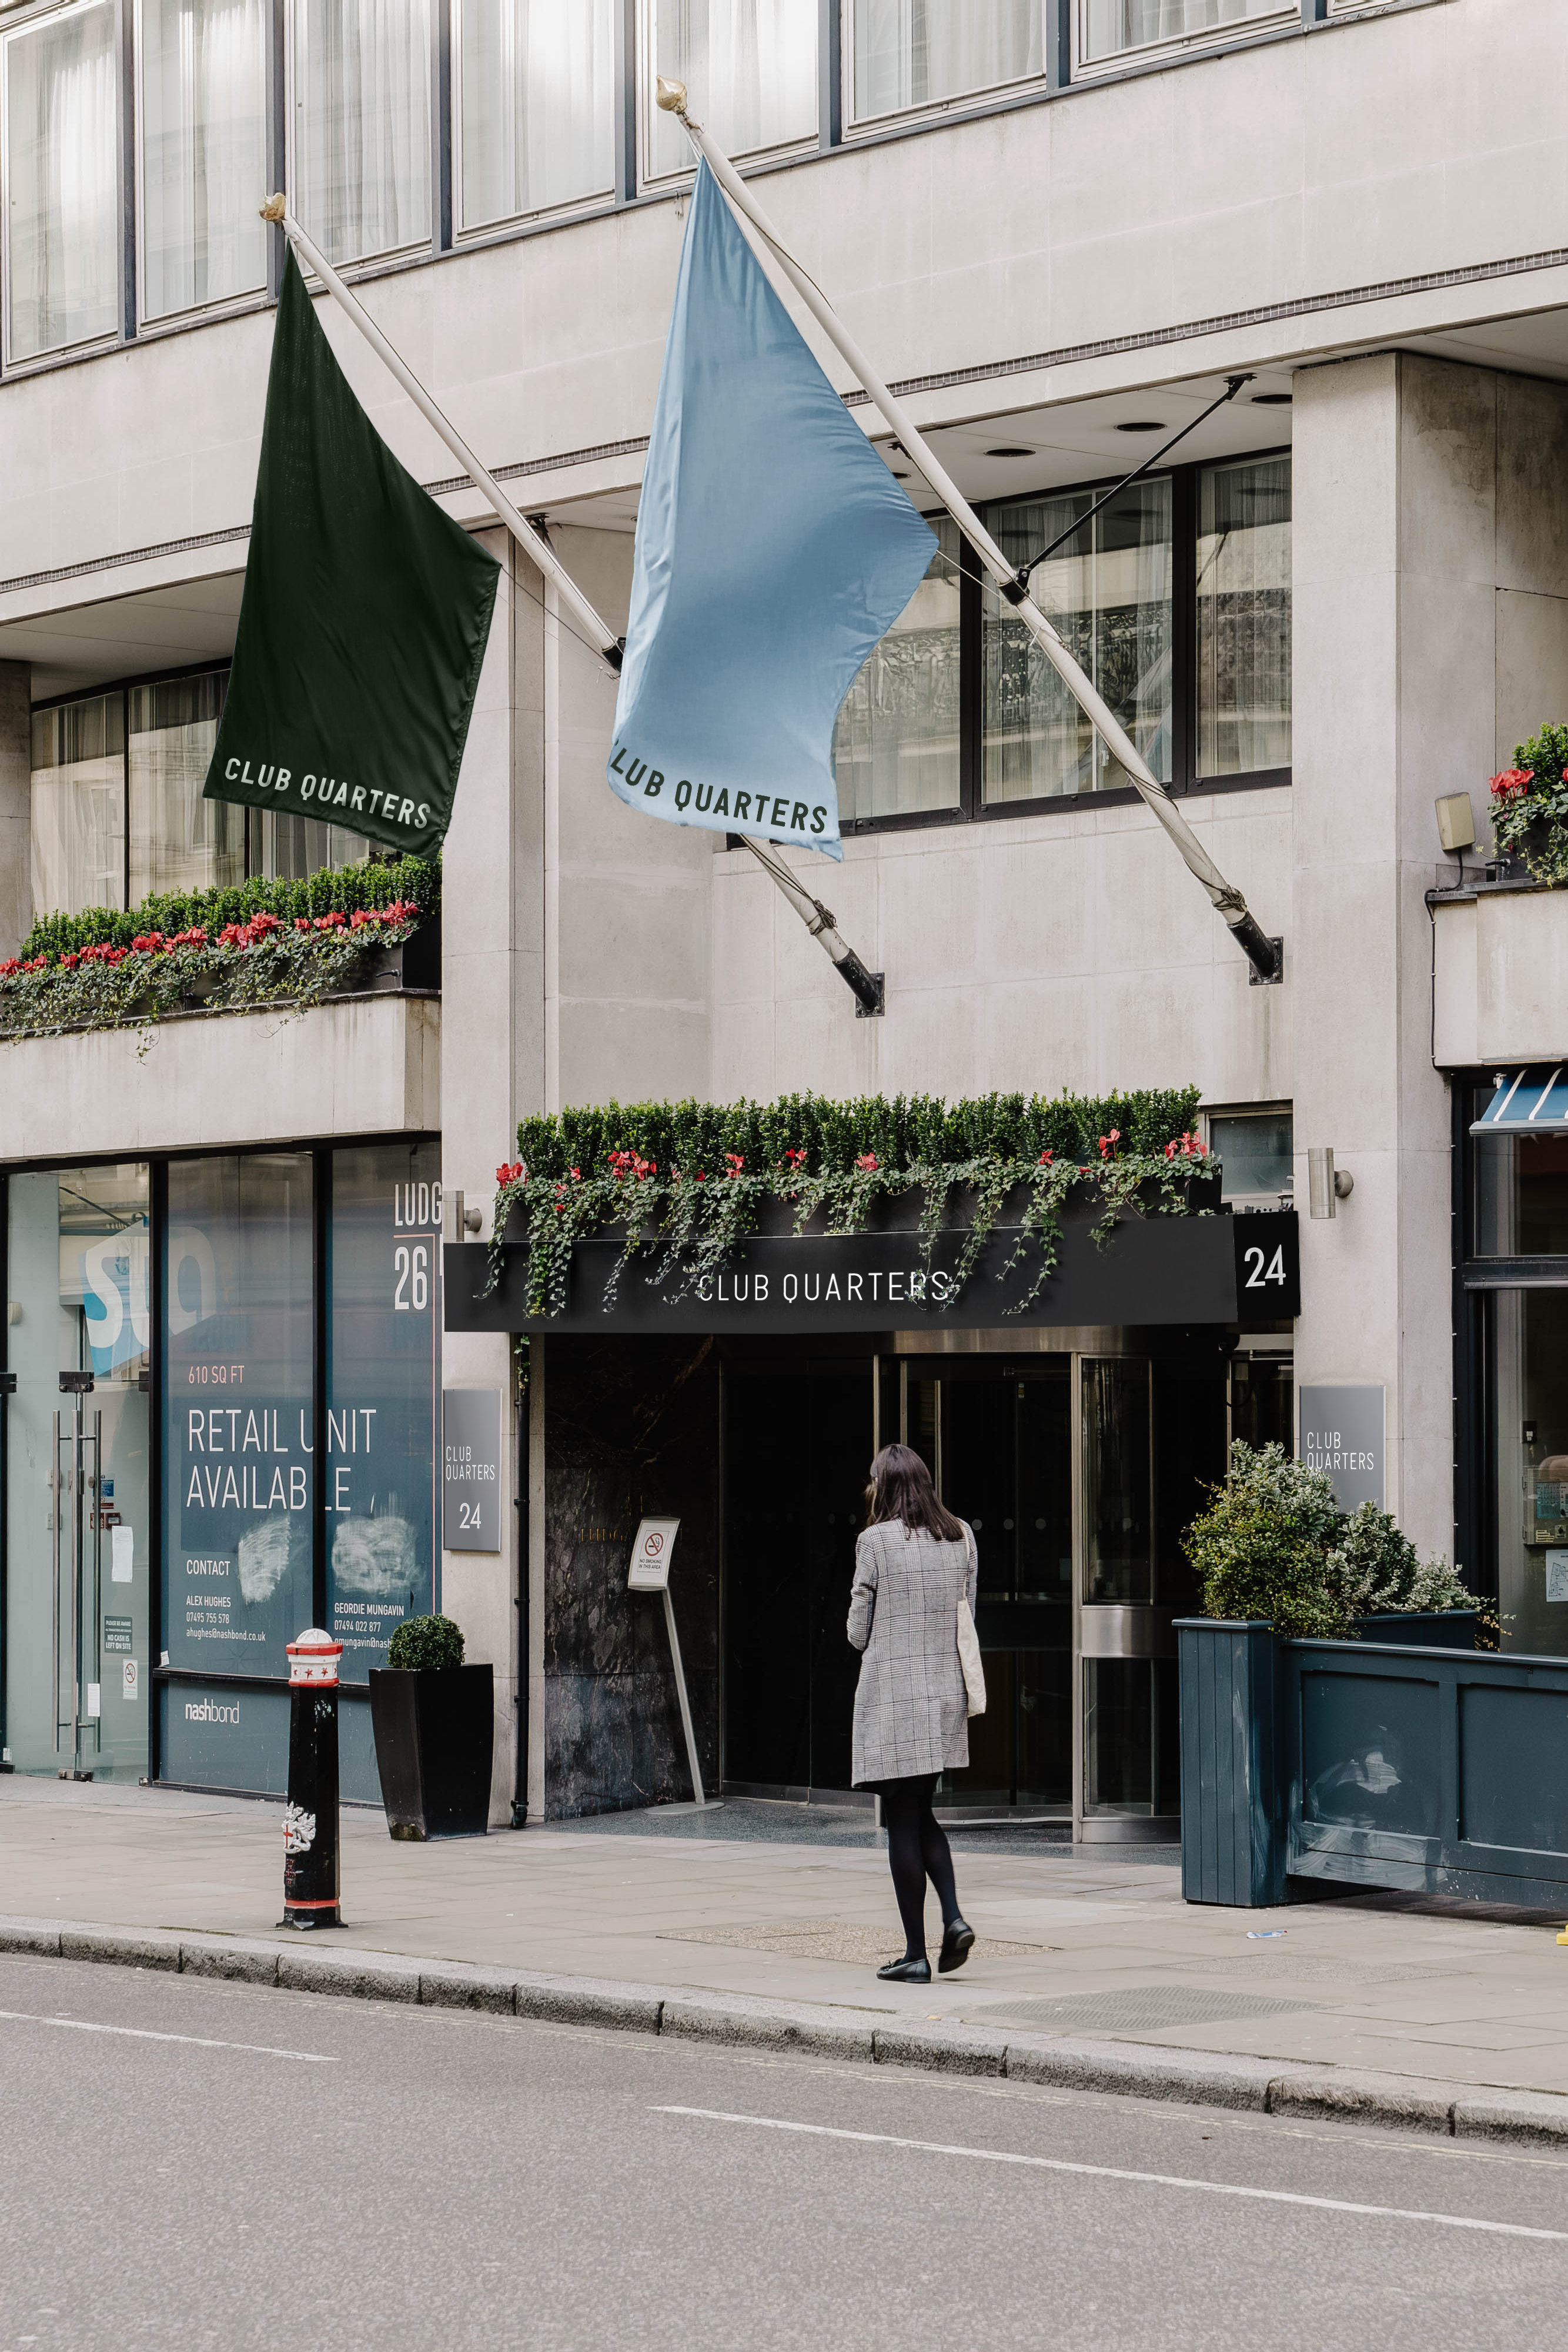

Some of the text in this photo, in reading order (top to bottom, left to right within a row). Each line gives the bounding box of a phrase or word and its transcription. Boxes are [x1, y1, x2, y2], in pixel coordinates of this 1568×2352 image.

[225, 757, 431, 829] CLUB QUARTERS
[610, 739, 828, 834] LUB QUARTERS
[1244, 1244, 1286, 1288] 24
[394, 1245, 427, 1310] 26
[700, 1271, 948, 1303] CLUB QUARTERS
[188, 1365, 245, 1384] 610 SQ FT
[189, 1409, 377, 1453] RETAIL UNIT
[1307, 1432, 1340, 1449] CLUB
[446, 1446, 471, 1462] CLUB
[1307, 1452, 1374, 1471] QUARTERS
[446, 1464, 495, 1481] QUARTERS
[186, 1465, 351, 1511] AVAILABE
[459, 1502, 482, 1529] 24
[186, 1559, 230, 1576] CONTACT
[186, 1595, 231, 1608] ALEX HUGHES
[335, 1602, 404, 1616] GEORDIE MUNGAVIN
[186, 1612, 229, 1624] 07495 755 578
[334, 1619, 381, 1632] 07494 022 877
[186, 1627, 266, 1641] ahughes@nashbond.co.uk
[185, 1698, 239, 1723] nashbond
